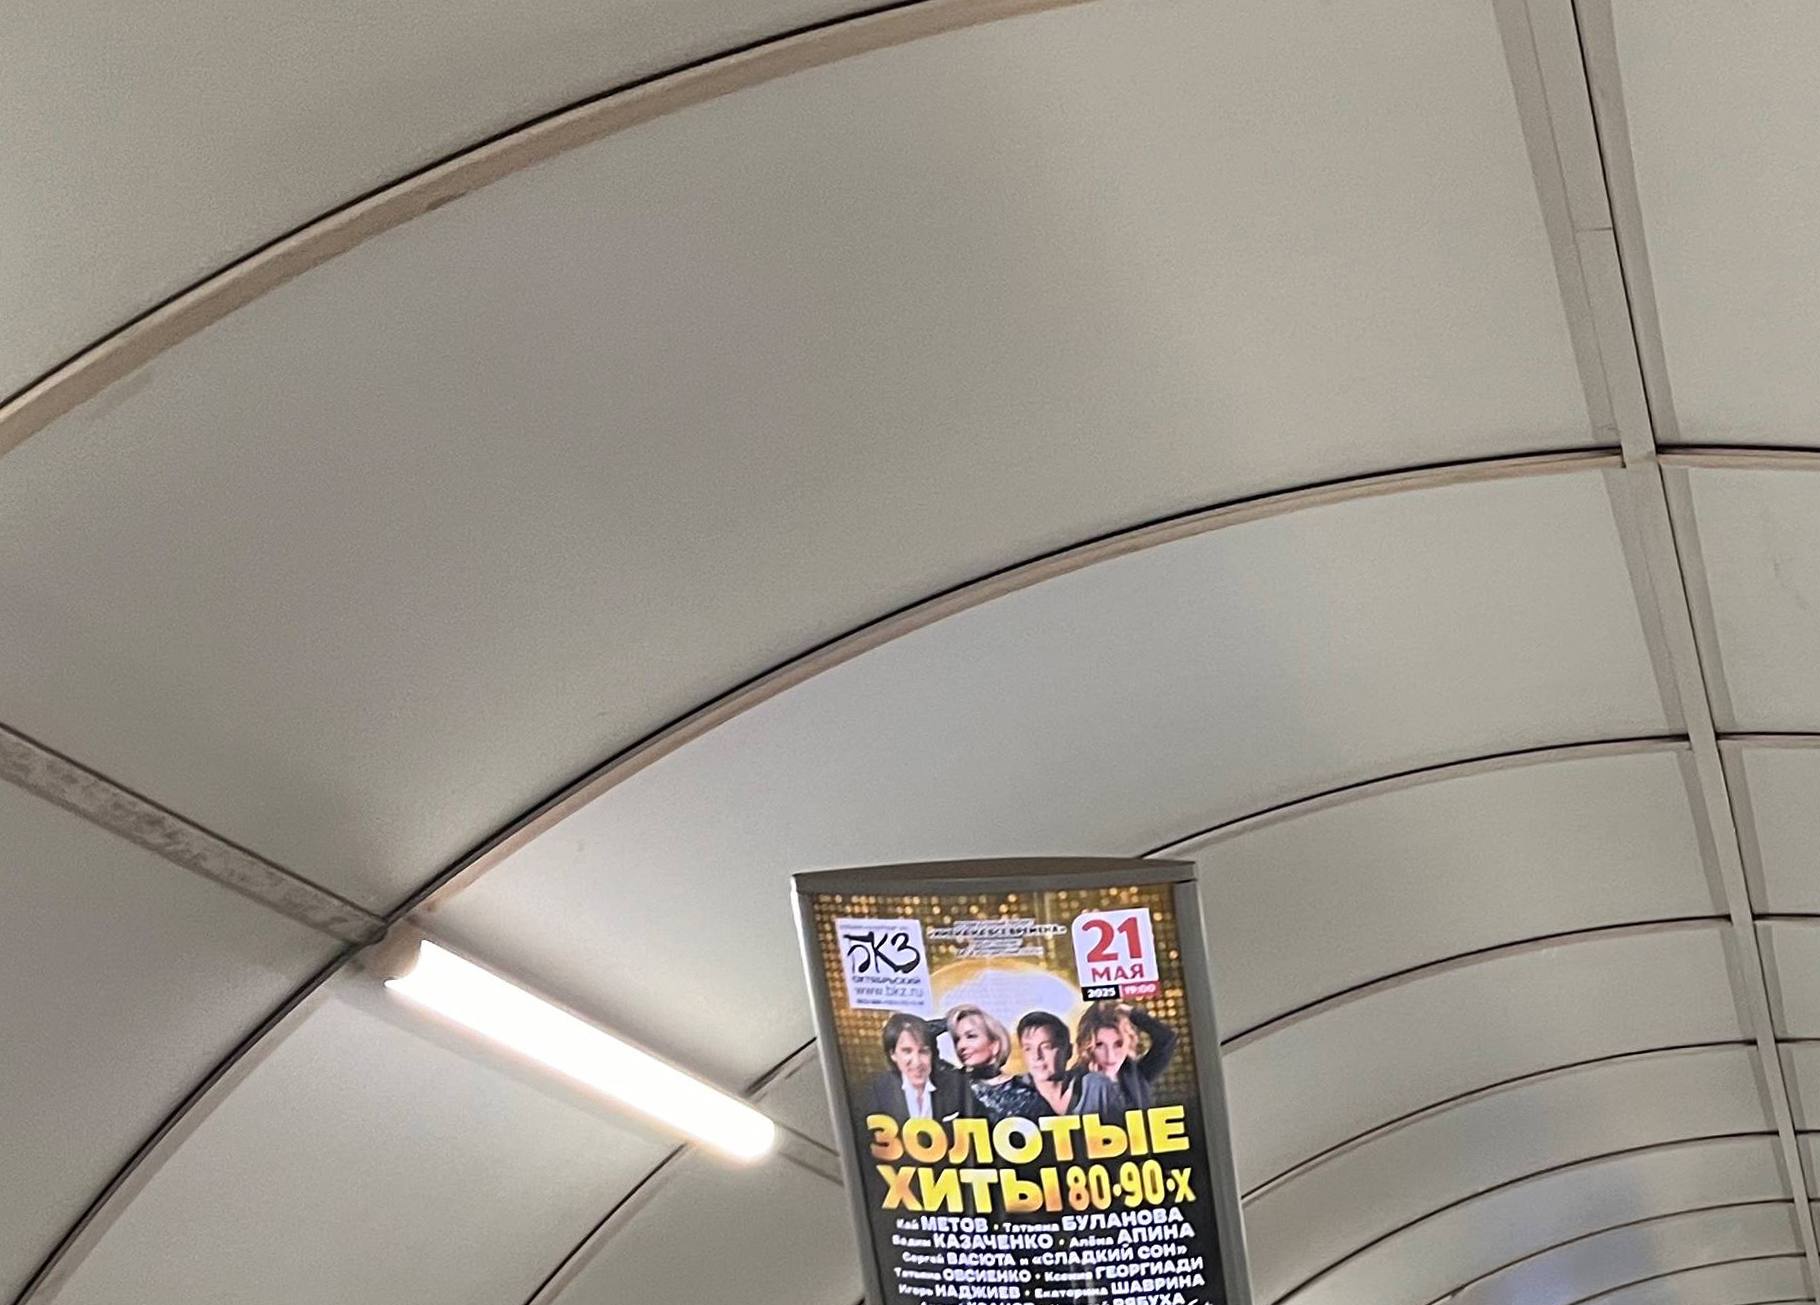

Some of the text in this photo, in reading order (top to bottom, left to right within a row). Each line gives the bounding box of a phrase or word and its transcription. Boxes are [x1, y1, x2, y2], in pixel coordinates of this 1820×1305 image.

[1082, 917, 1142, 963] 21
[1091, 963, 1144, 983] МАЯ
[1087, 986, 1116, 999] 2025
[866, 1105, 1190, 1165] ЗОЛОТЫЕ
[876, 1164, 1063, 1214] ХИТЫ
[920, 1216, 989, 1233] МЕТОВ
[1061, 1206, 1184, 1232] БУЛАНОВА
[933, 1232, 1054, 1250] КАЗАЧЕНКО
[1117, 1222, 1196, 1245] АПИНА
[946, 1252, 1017, 1267] ВАСЮТА
[1032, 1243, 1134, 1267] «СЛАДКИЙ
[1137, 1243, 1188, 1260] СОН»
[942, 1268, 1032, 1283] ОВСИЕНКО
[1095, 1256, 1205, 1280] ГЕОРГИАДИ
[934, 1284, 1022, 1300] НАДЖИЕВ
[1111, 1273, 1206, 1296] ШАВРИНА
